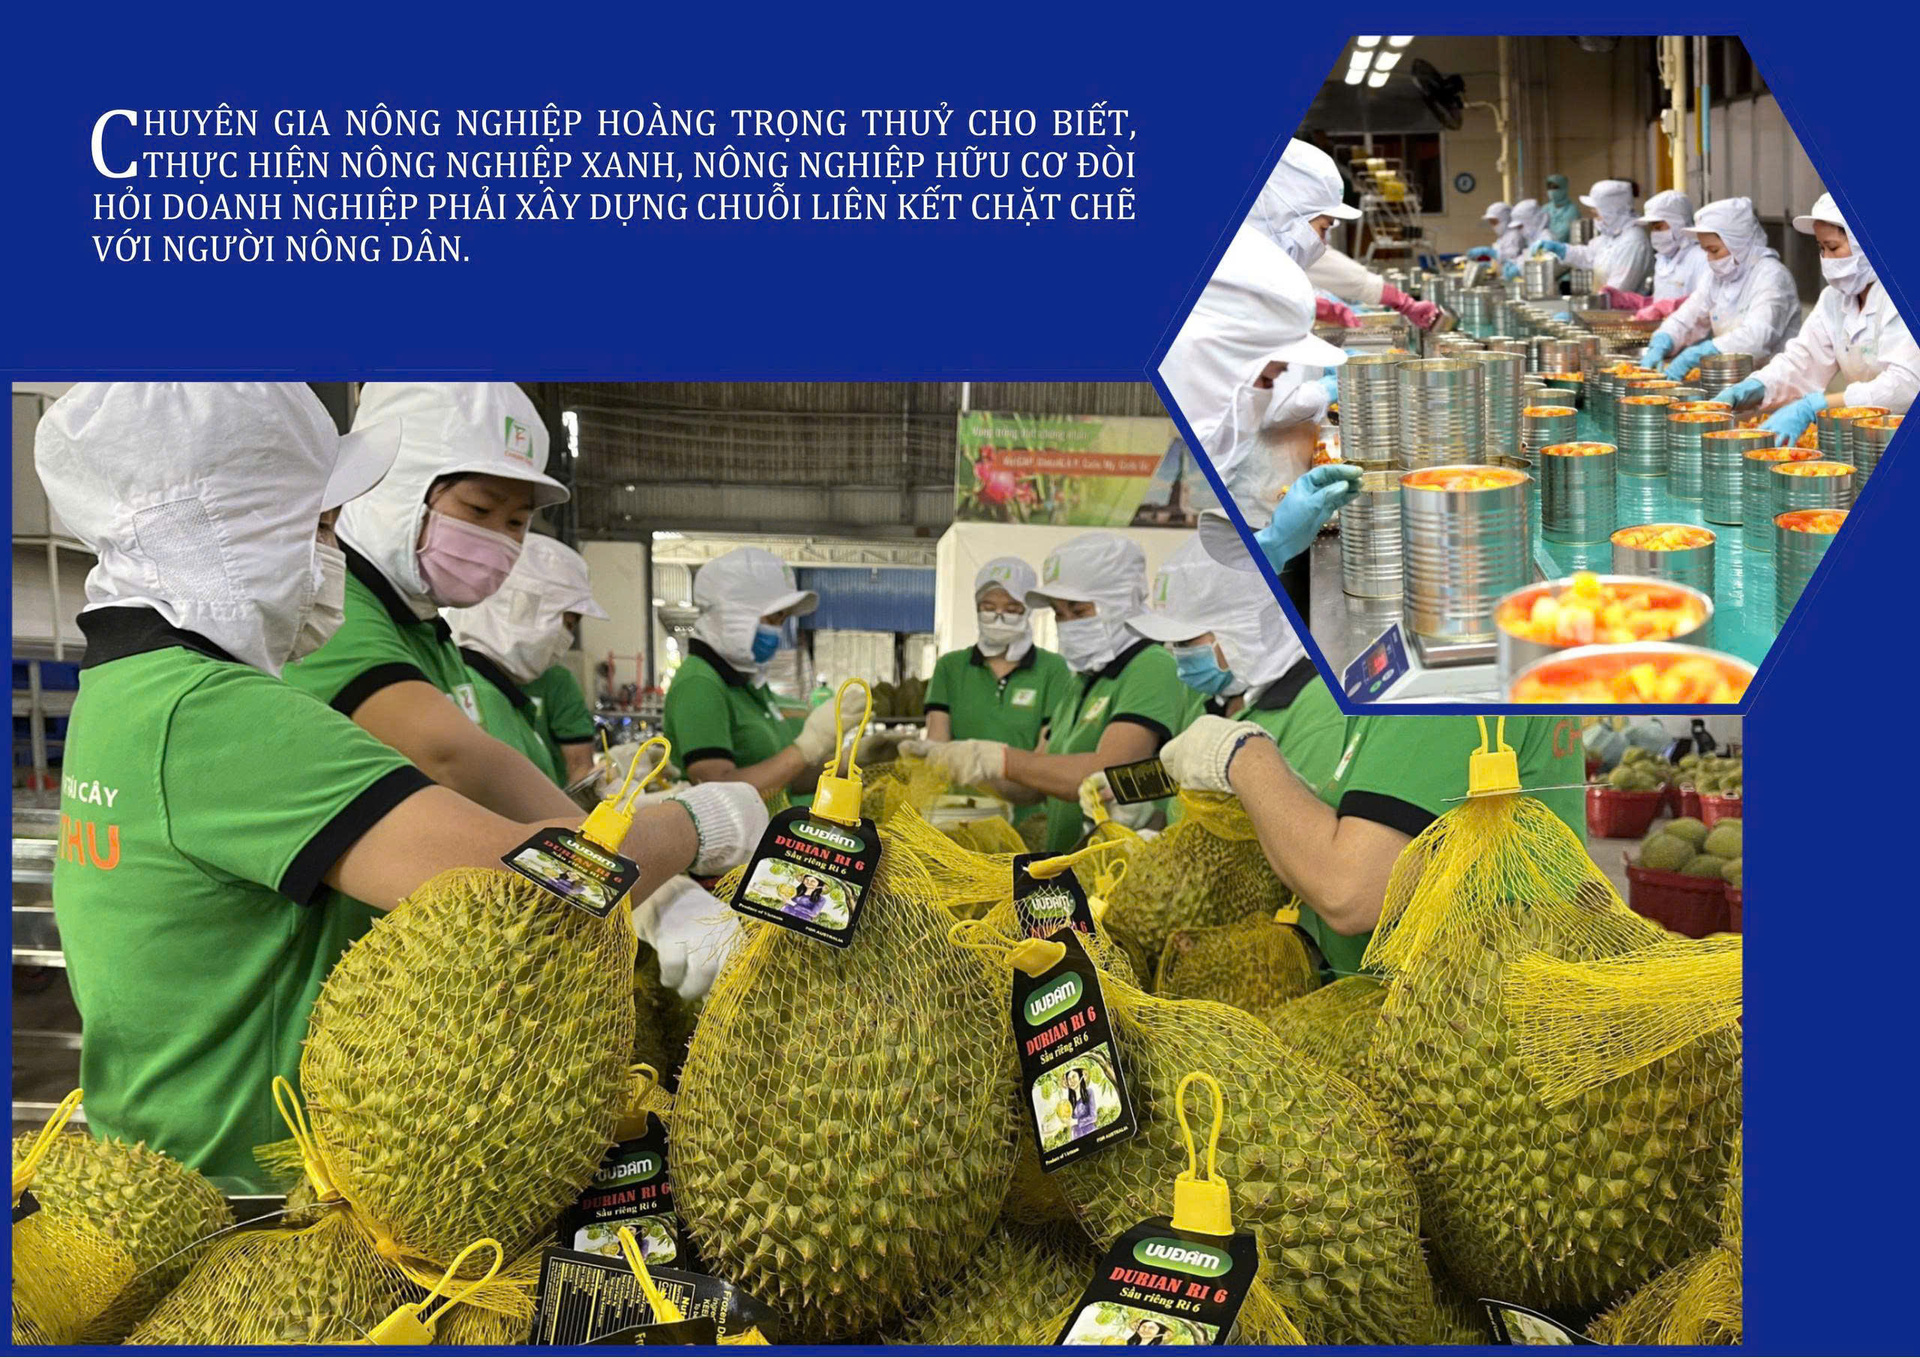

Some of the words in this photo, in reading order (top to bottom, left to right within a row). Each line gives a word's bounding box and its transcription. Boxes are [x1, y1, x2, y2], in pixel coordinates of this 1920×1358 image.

[78, 780, 119, 808] CÂY
[543, 840, 594, 868] DURIAN
[775, 835, 831, 860] DURIAN
[835, 853, 852, 867] RI
[855, 860, 865, 871] 6
[804, 856, 827, 870] riêng
[828, 863, 840, 873] Ri
[1026, 1020, 1069, 1056] DURIAN
[1070, 1011, 1086, 1032] RI
[1087, 1006, 1097, 1022] 6
[1054, 1042, 1074, 1057] riêng
[1073, 1034, 1083, 1047] Ri
[1083, 1031, 1089, 1042] 6
[582, 1189, 636, 1210] DURIAN
[641, 1185, 657, 1199] RI
[661, 1182, 671, 1195] 6
[614, 1205, 638, 1215] riêng
[639, 1201, 650, 1211] Ri
[651, 1201, 658, 1209] 6
[1109, 1266, 1183, 1294] DURIAN
[1185, 1282, 1211, 1300] RI
[1213, 1288, 1229, 1304] 6
[719, 1290, 733, 1324] Frozen
[1119, 1286, 1142, 1301] Sầu
[1143, 1293, 1175, 1310] riêng
[1175, 1299, 1192, 1311] Ri
[1192, 1304, 1202, 1313] 6
